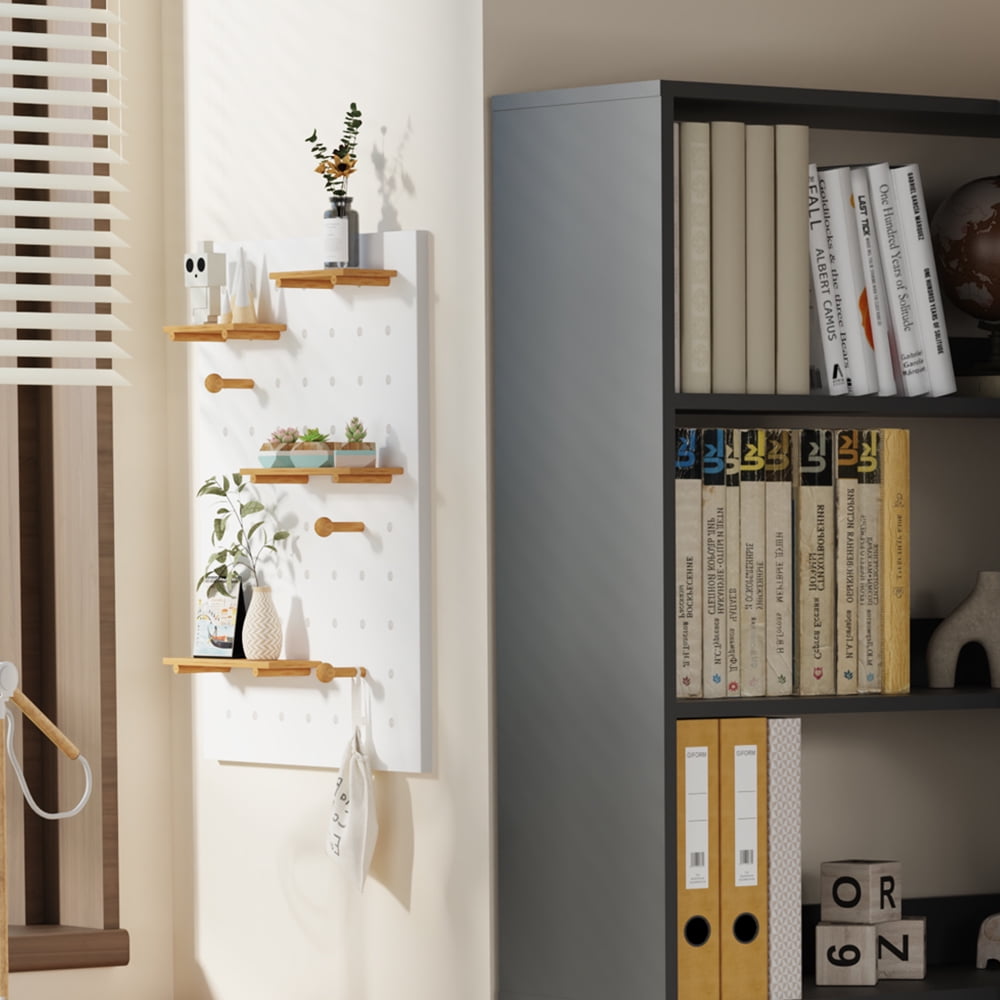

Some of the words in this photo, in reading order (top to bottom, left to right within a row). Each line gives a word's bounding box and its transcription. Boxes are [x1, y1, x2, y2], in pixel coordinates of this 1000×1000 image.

[808, 184, 822, 231] FALL
[857, 194, 869, 216] LAST
[879, 183, 890, 206] One
[819, 178, 834, 250] Goldilocks
[861, 217, 872, 237] TICK
[882, 207, 899, 250] Hundred
[815, 248, 831, 294] ALBERT
[890, 250, 902, 278] Years
[923, 267, 931, 278] ONE
[831, 268, 840, 291] the
[895, 279, 908, 291] of
[925, 279, 935, 303] HUNDRED
[822, 299, 837, 342] CAMUS
[834, 293, 845, 328] three
[897, 292, 915, 332] Solitude
[929, 303, 938, 321] YEARS
[839, 331, 850, 369] Bears
[934, 329, 944, 355] SOLITUDE
[832, 876, 861, 909] O
[880, 875, 896, 910] R
